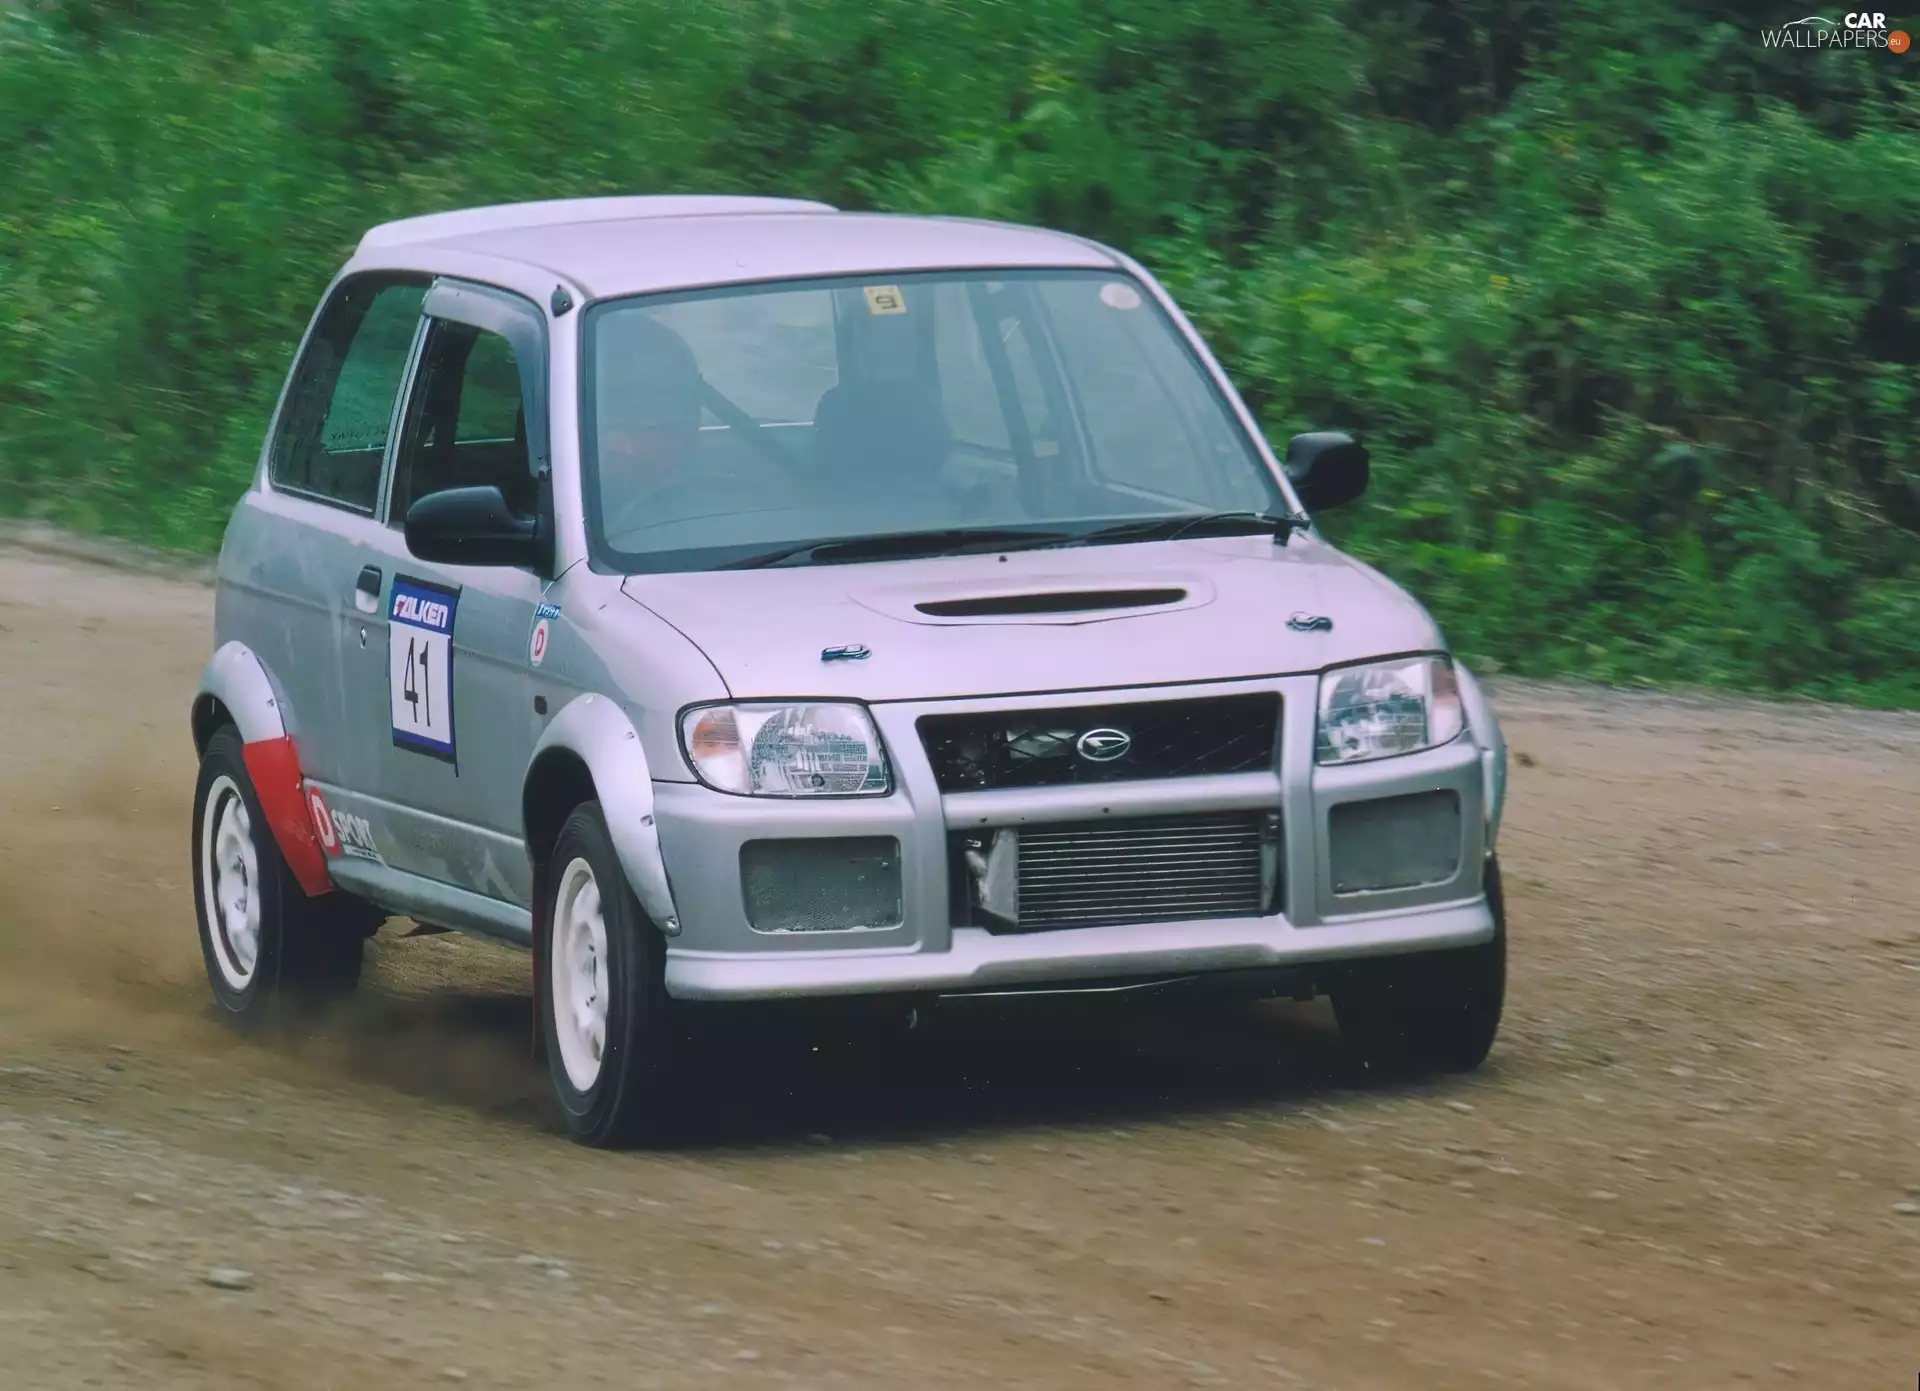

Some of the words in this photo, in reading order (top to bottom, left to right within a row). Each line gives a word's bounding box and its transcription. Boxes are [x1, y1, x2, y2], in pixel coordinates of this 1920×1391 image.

[393, 594, 448, 628] FALKEN
[404, 637, 431, 728] 41
[311, 793, 336, 848] D
[330, 808, 378, 853] SPORT
